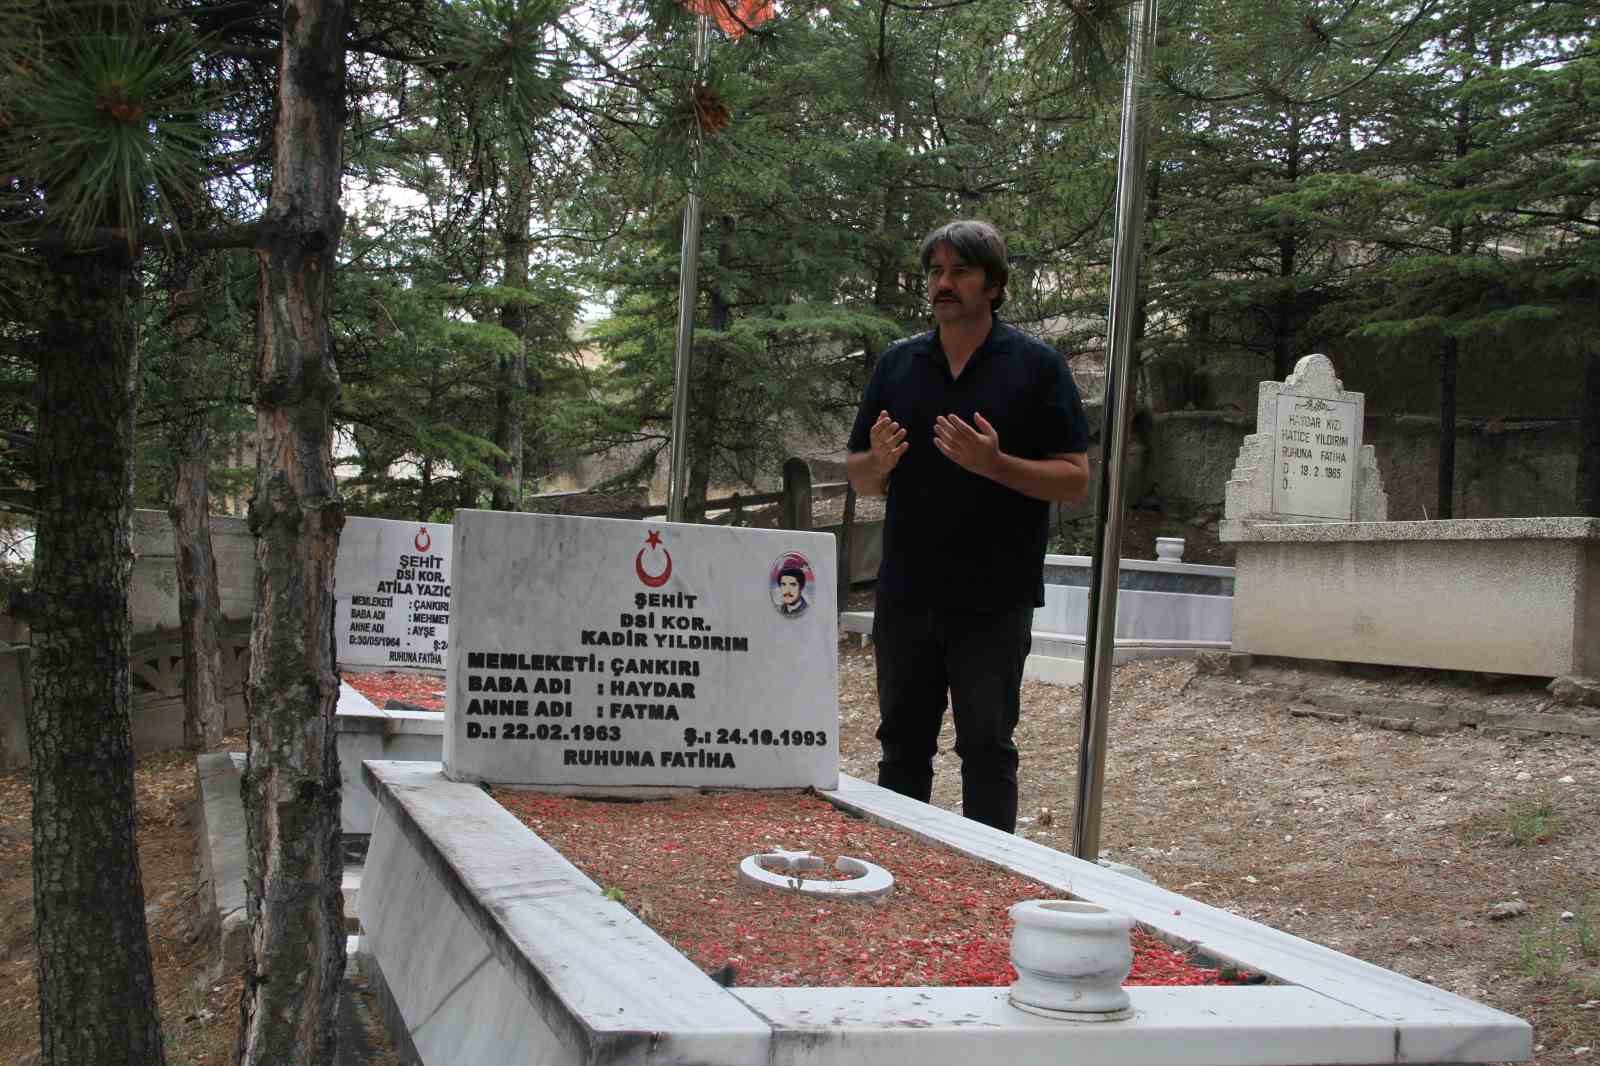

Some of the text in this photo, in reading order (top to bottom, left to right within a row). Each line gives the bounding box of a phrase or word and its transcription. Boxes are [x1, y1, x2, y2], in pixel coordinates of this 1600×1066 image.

[1281, 446, 1312, 459] RUHUNA
[400, 555, 443, 568] ŞEHİT
[396, 568, 445, 583] DSİ KOR.
[377, 580, 413, 595] ATİLA
[634, 591, 698, 610] ŞEHİT
[351, 608, 371, 619] BABA
[373, 609, 385, 620] ADI
[620, 611, 712, 632] DSİ KOR.
[350, 622, 370, 633] ANNE
[372, 623, 384, 633] ADI
[413, 626, 435, 638] AYŞE
[581, 629, 748, 652] KADİR YILDIRIM
[389, 651, 417, 663] RUHUNA
[610, 658, 700, 677] ÇANKIRI
[468, 675, 528, 693] BABA
[533, 677, 571, 695] ADI
[610, 680, 696, 699] HAYDAR
[466, 699, 529, 716] ANNE
[534, 701, 572, 717] ADI
[610, 703, 679, 720] FATMA
[502, 723, 621, 741] 22.02.1963
[716, 728, 827, 746] 24.10.1993
[563, 748, 736, 768] RUHUNA FATİHA
